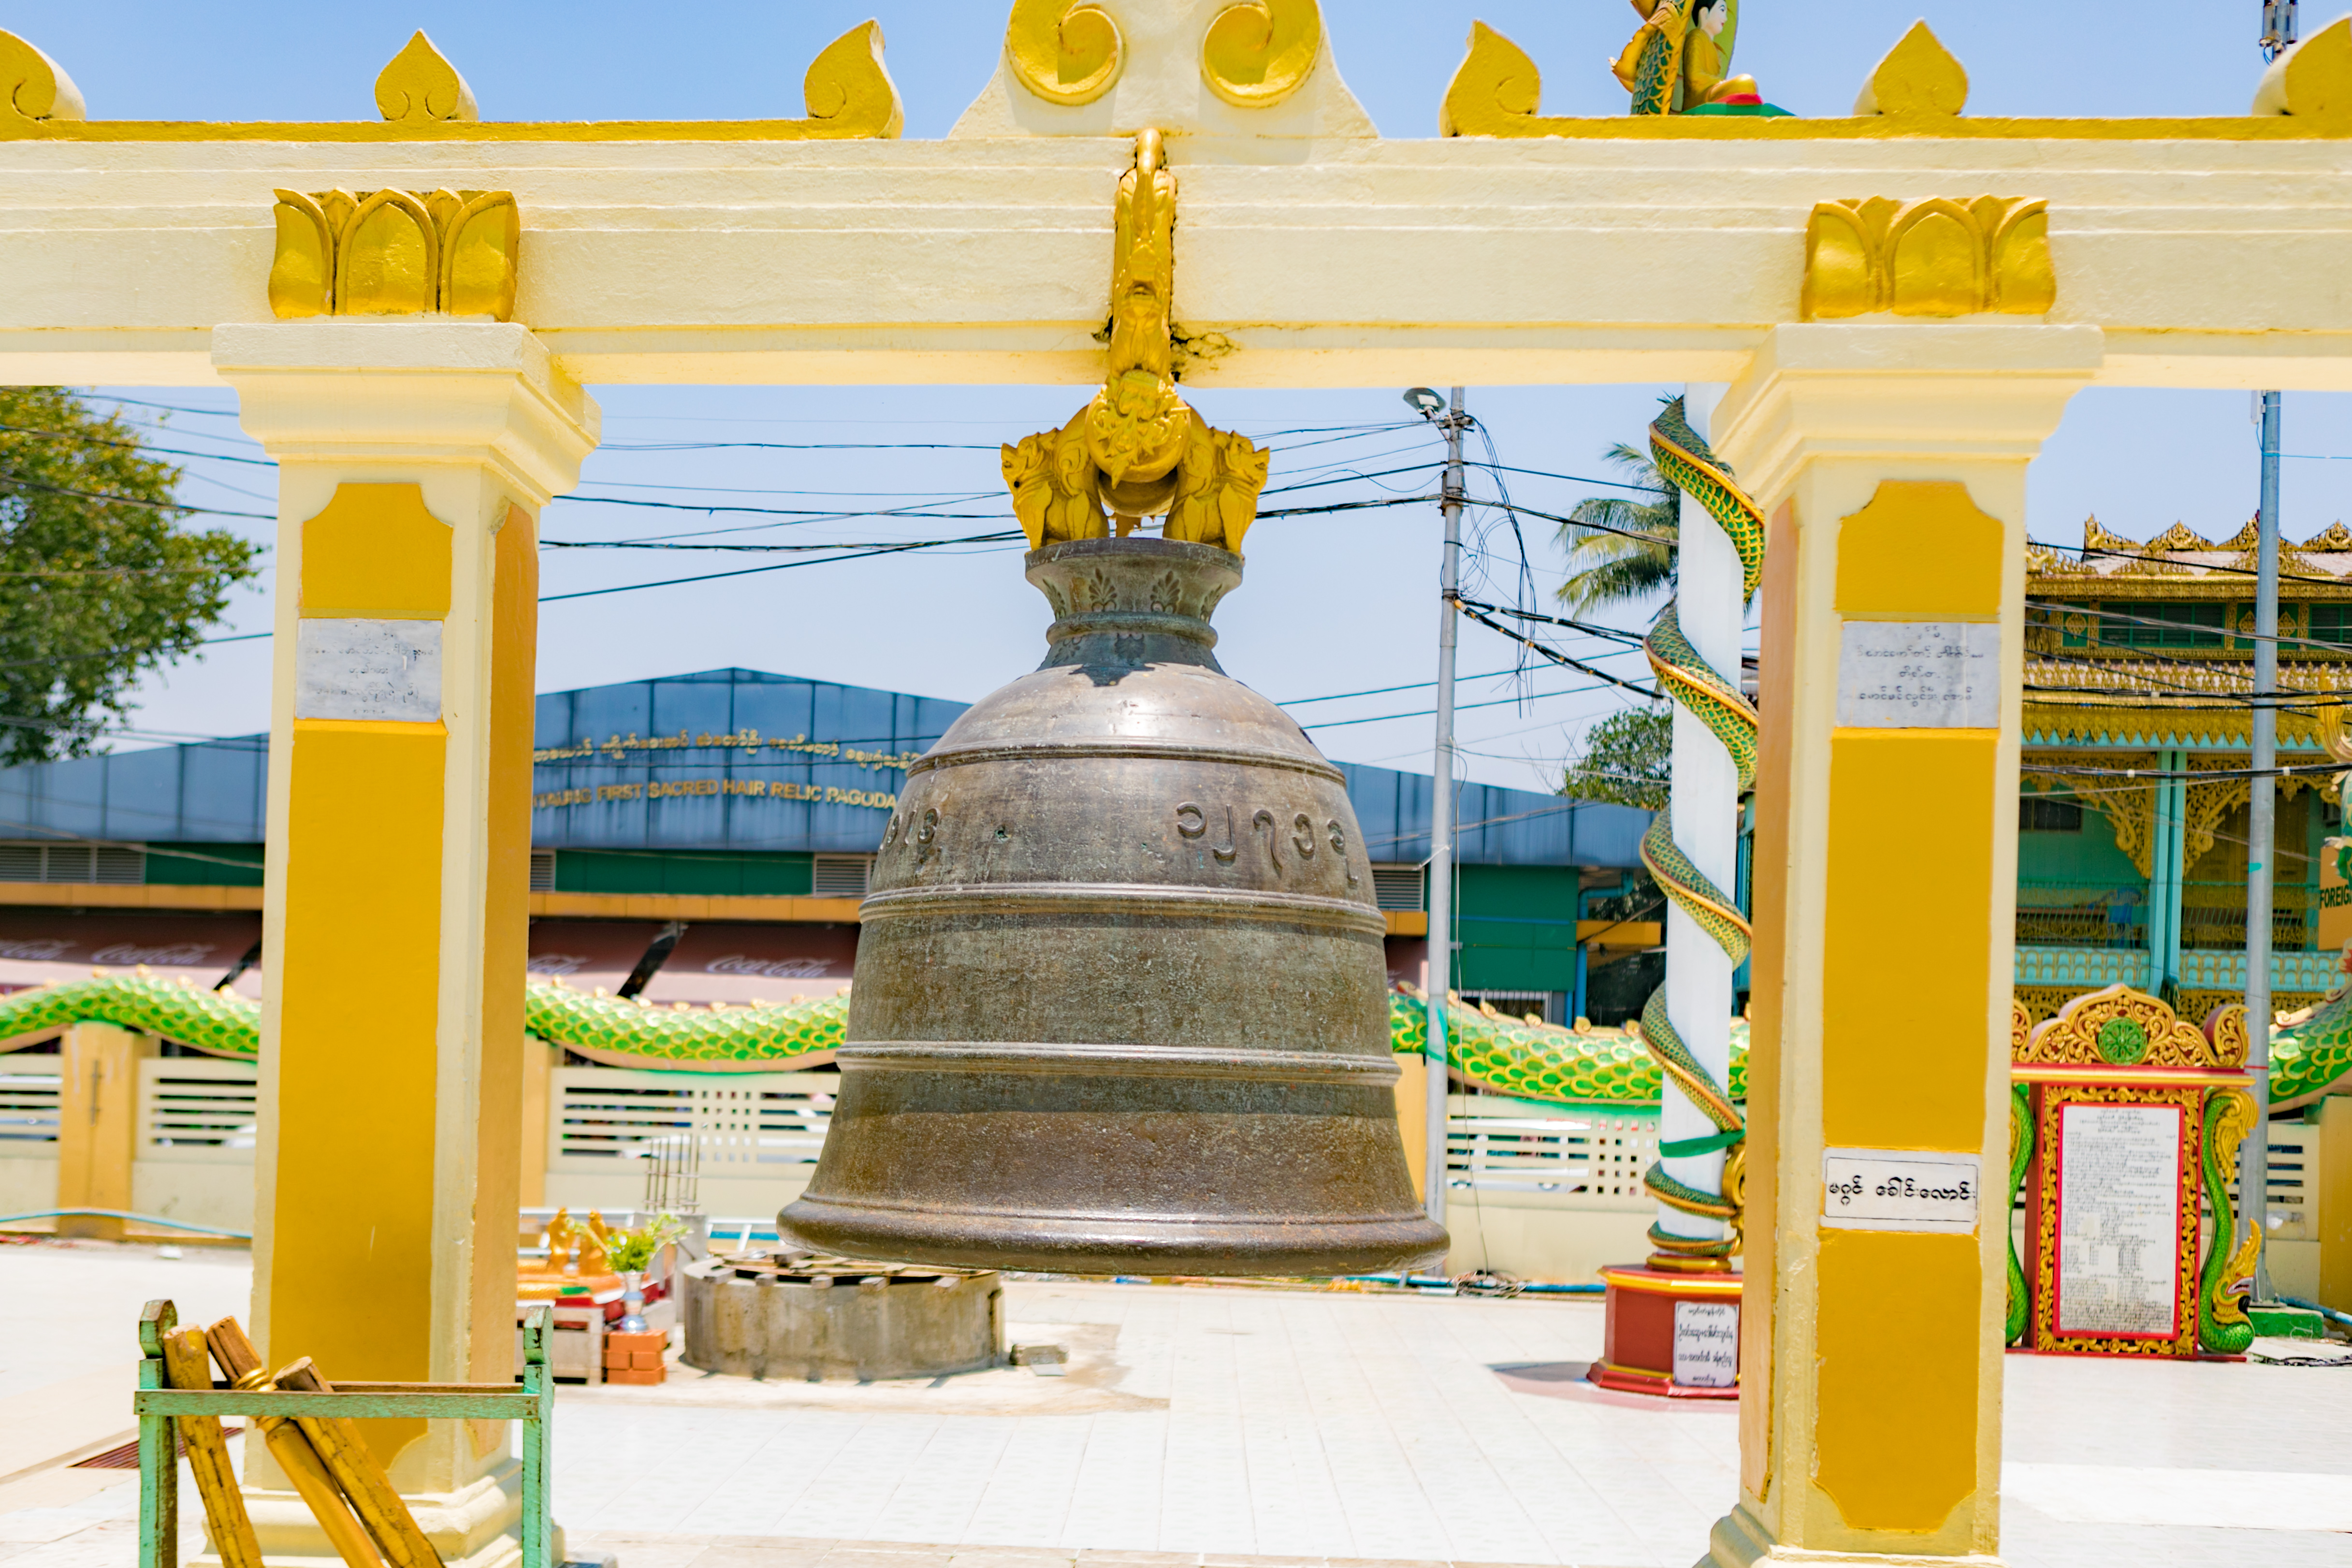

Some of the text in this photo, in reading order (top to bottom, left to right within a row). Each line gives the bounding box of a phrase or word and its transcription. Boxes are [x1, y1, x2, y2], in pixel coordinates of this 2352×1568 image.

[597, 783, 644, 802] FIRST
[648, 779, 719, 799] SACRED
[722, 778, 766, 796] HAIR
[770, 782, 822, 802] RELIC
[826, 786, 897, 809] PAGODA
